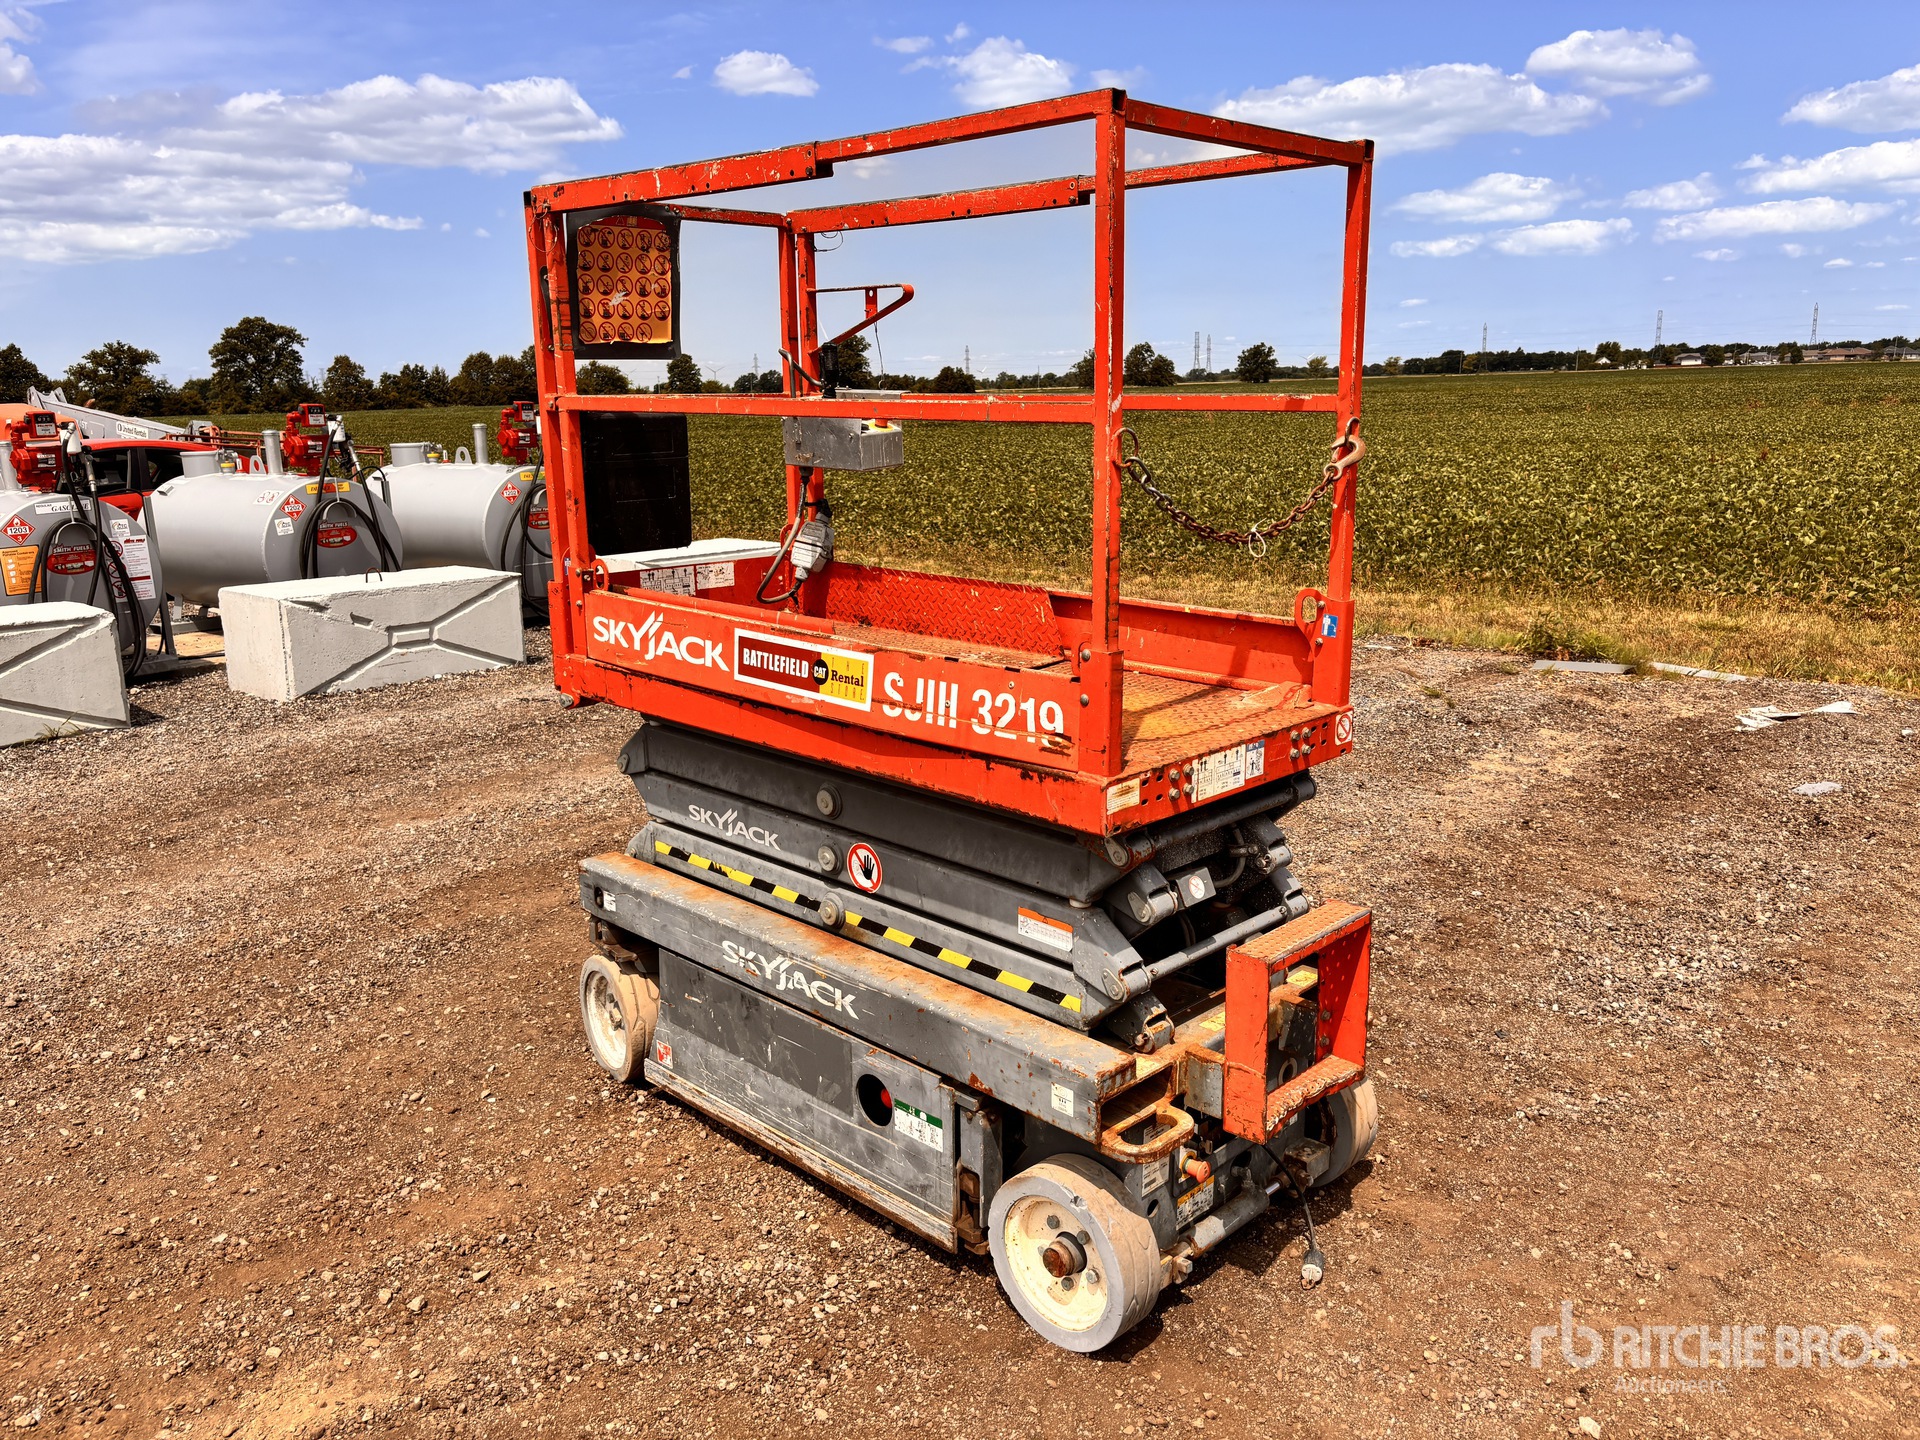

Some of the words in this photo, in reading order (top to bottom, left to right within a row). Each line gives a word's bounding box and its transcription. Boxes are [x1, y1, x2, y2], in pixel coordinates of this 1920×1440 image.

[592, 610, 730, 672] SKYJACK
[743, 648, 809, 679] BATTLEFIELD
[813, 665, 827, 679] CAT
[830, 669, 864, 687] Rental
[970, 689, 1065, 747] 3219
[688, 804, 781, 851] SKYJACK
[721, 940, 859, 1020] SKYJACK
